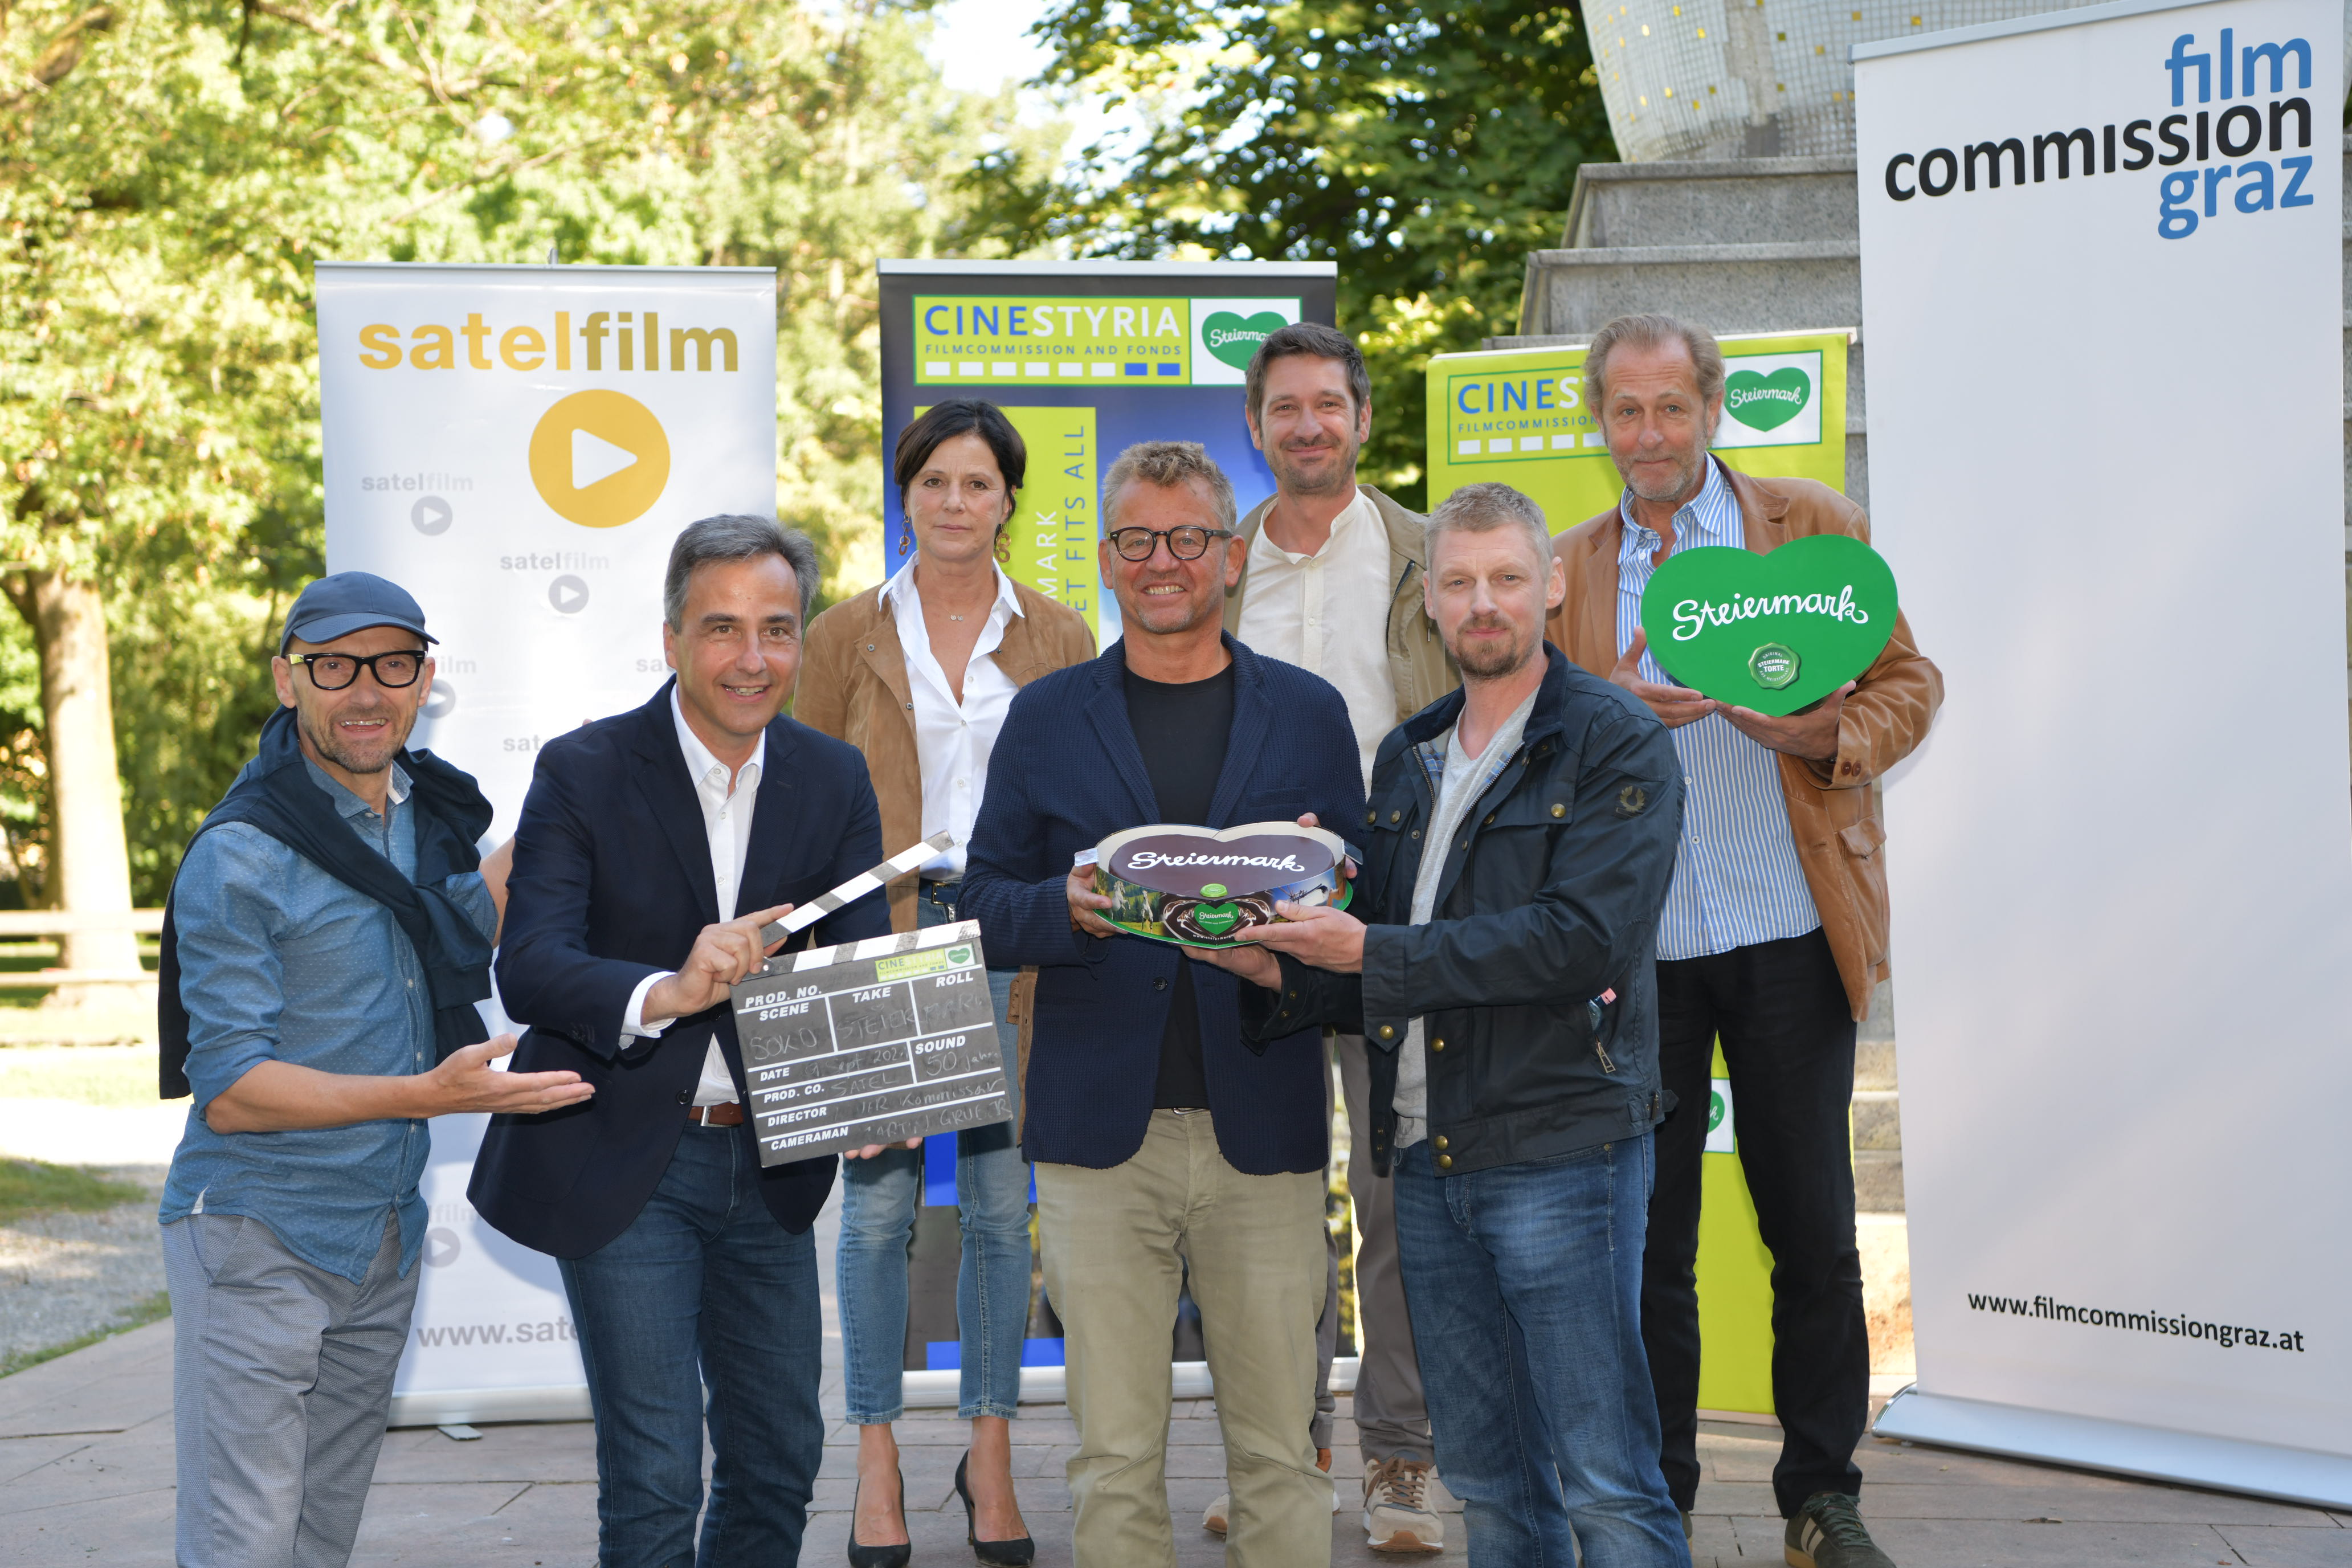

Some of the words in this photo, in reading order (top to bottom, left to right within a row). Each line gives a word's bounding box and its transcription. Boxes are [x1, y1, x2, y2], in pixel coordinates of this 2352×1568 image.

[2165, 27, 2312, 107] film
[1885, 97, 2312, 201] commission
[2158, 155, 2314, 239] graz
[924, 305, 1181, 337] CINESTYRIA
[358, 311, 738, 371] satelfilm
[1210, 329, 1271, 348] Steierma
[926, 345, 1075, 354] FILMCOMMISSION
[1085, 345, 1117, 355] AND
[1128, 345, 1181, 355] FONDS
[1730, 386, 1802, 408] Steiermark
[1064, 426, 1084, 480] ALL
[361, 473, 473, 491] satelfilm
[1064, 497, 1085, 560] FITS
[500, 553, 609, 570] satelfilm
[1673, 585, 1869, 641] Steiermark
[1128, 852, 1305, 872] Steiermark
[878, 952, 943, 970] CINESTYRIA
[936, 971, 974, 987] ROLL
[745, 991, 790, 1008] PROD.
[797, 985, 822, 998] NO.
[852, 987, 891, 1003] TAKE
[760, 1003, 809, 1020] SCENE
[915, 1035, 966, 1054] SOUND
[760, 1067, 790, 1081] DATE
[926, 1051, 957, 1076] 50
[764, 1089, 800, 1103] PROD.
[805, 1084, 824, 1095] CO.
[831, 1072, 899, 1096] SATEL
[768, 1106, 827, 1126] DIRECTOR
[771, 1126, 848, 1150] CAMERAMAN
[1967, 1292, 2304, 1353] www.filmcommissiongraz.at
